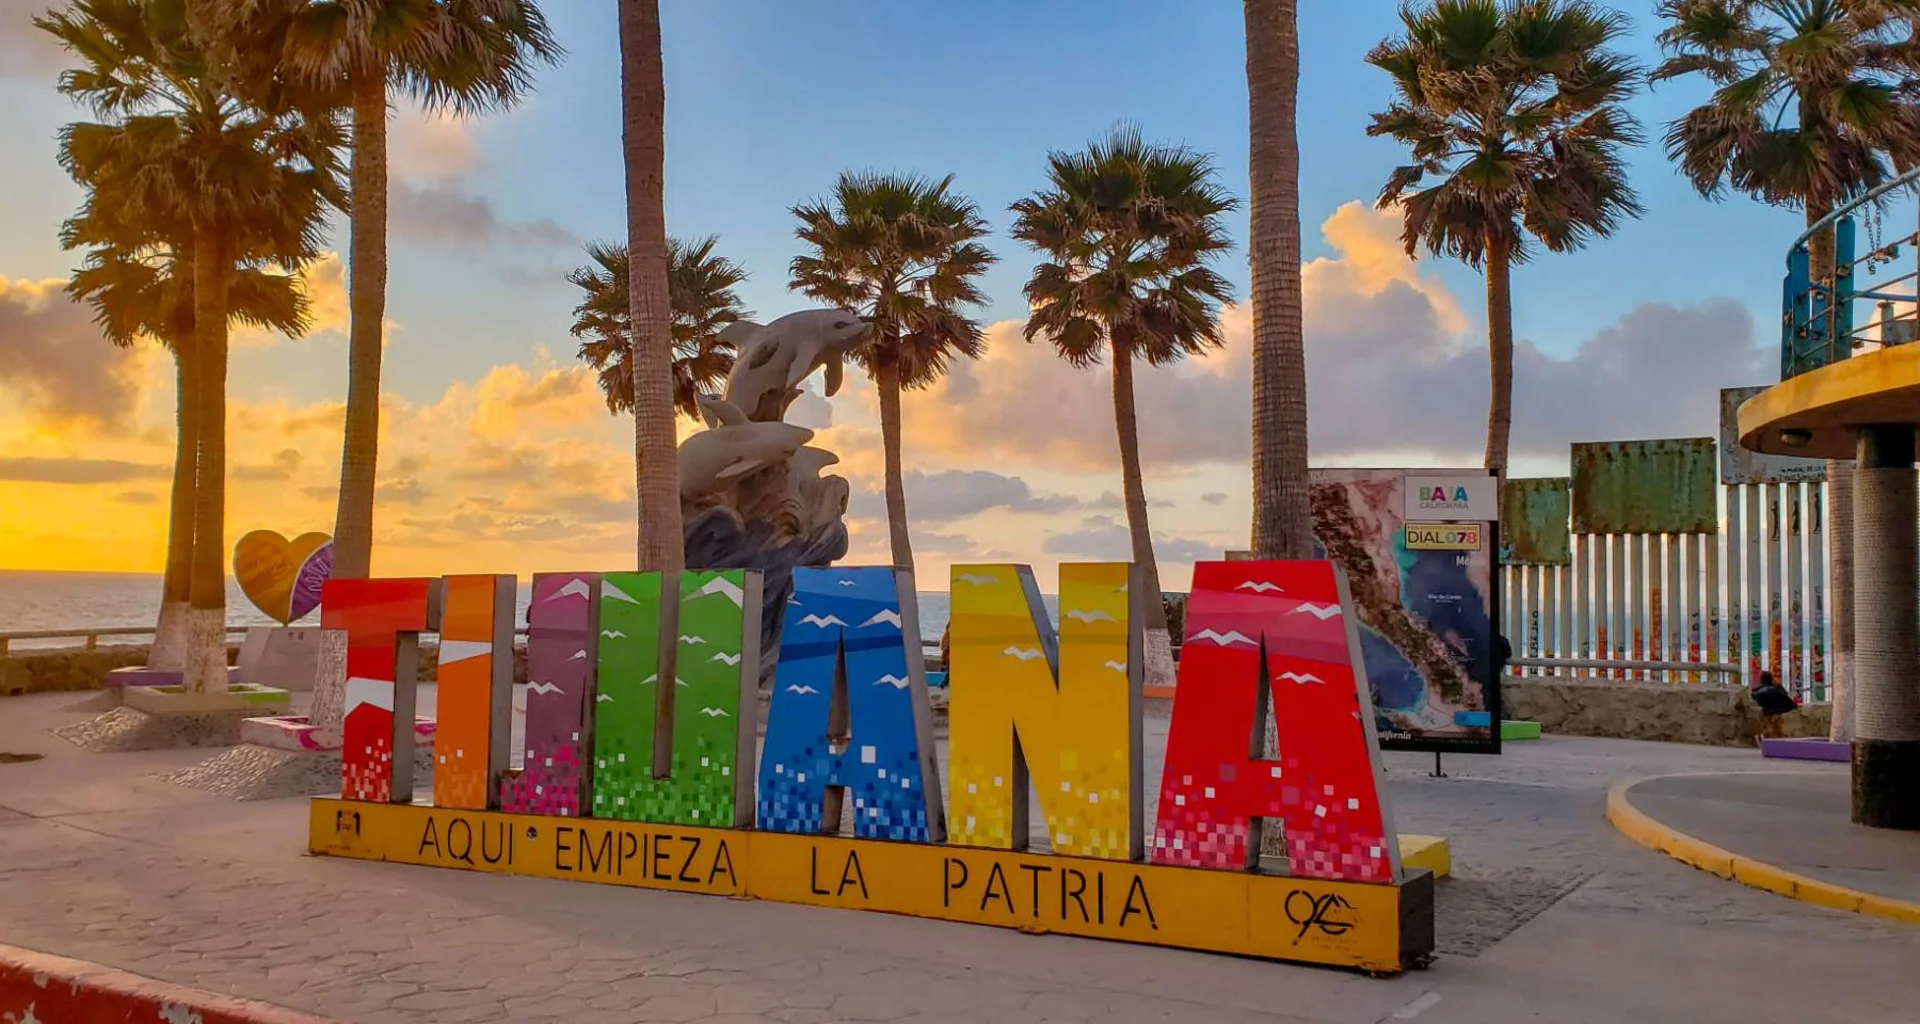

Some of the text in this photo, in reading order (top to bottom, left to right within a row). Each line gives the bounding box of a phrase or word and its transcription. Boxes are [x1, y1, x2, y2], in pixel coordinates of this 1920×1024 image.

[1420, 487, 1468, 501] BAJA
[1408, 531, 1477, 544] DIAL 078
[321, 560, 1395, 884] TIJUANA
[1378, 731, 1411, 741] alifornia
[418, 816, 513, 865] AQUI
[555, 827, 737, 887] EMPIEZA
[811, 847, 869, 900] LA
[944, 858, 1158, 930] PATRIA
